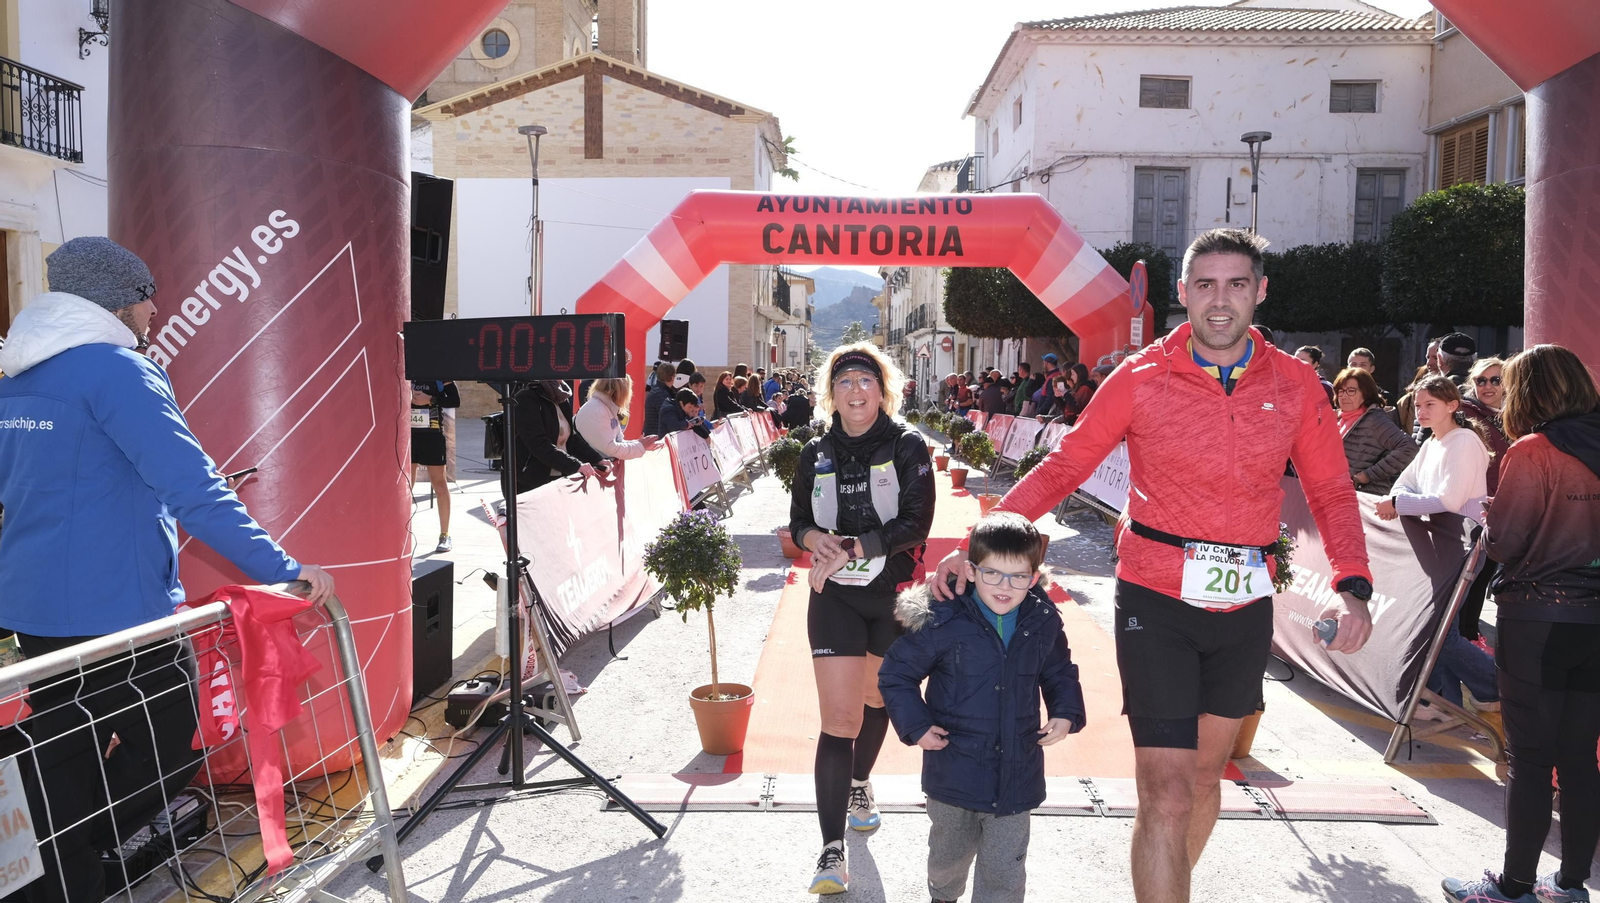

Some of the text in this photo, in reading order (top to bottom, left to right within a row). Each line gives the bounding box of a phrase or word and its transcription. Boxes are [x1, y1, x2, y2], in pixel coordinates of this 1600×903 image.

[757, 195, 973, 215] AYUNTAMIENTO
[762, 222, 964, 256] CANTORIA
[1209, 555, 1245, 566] POLVORA
[1204, 566, 1252, 594] 201
